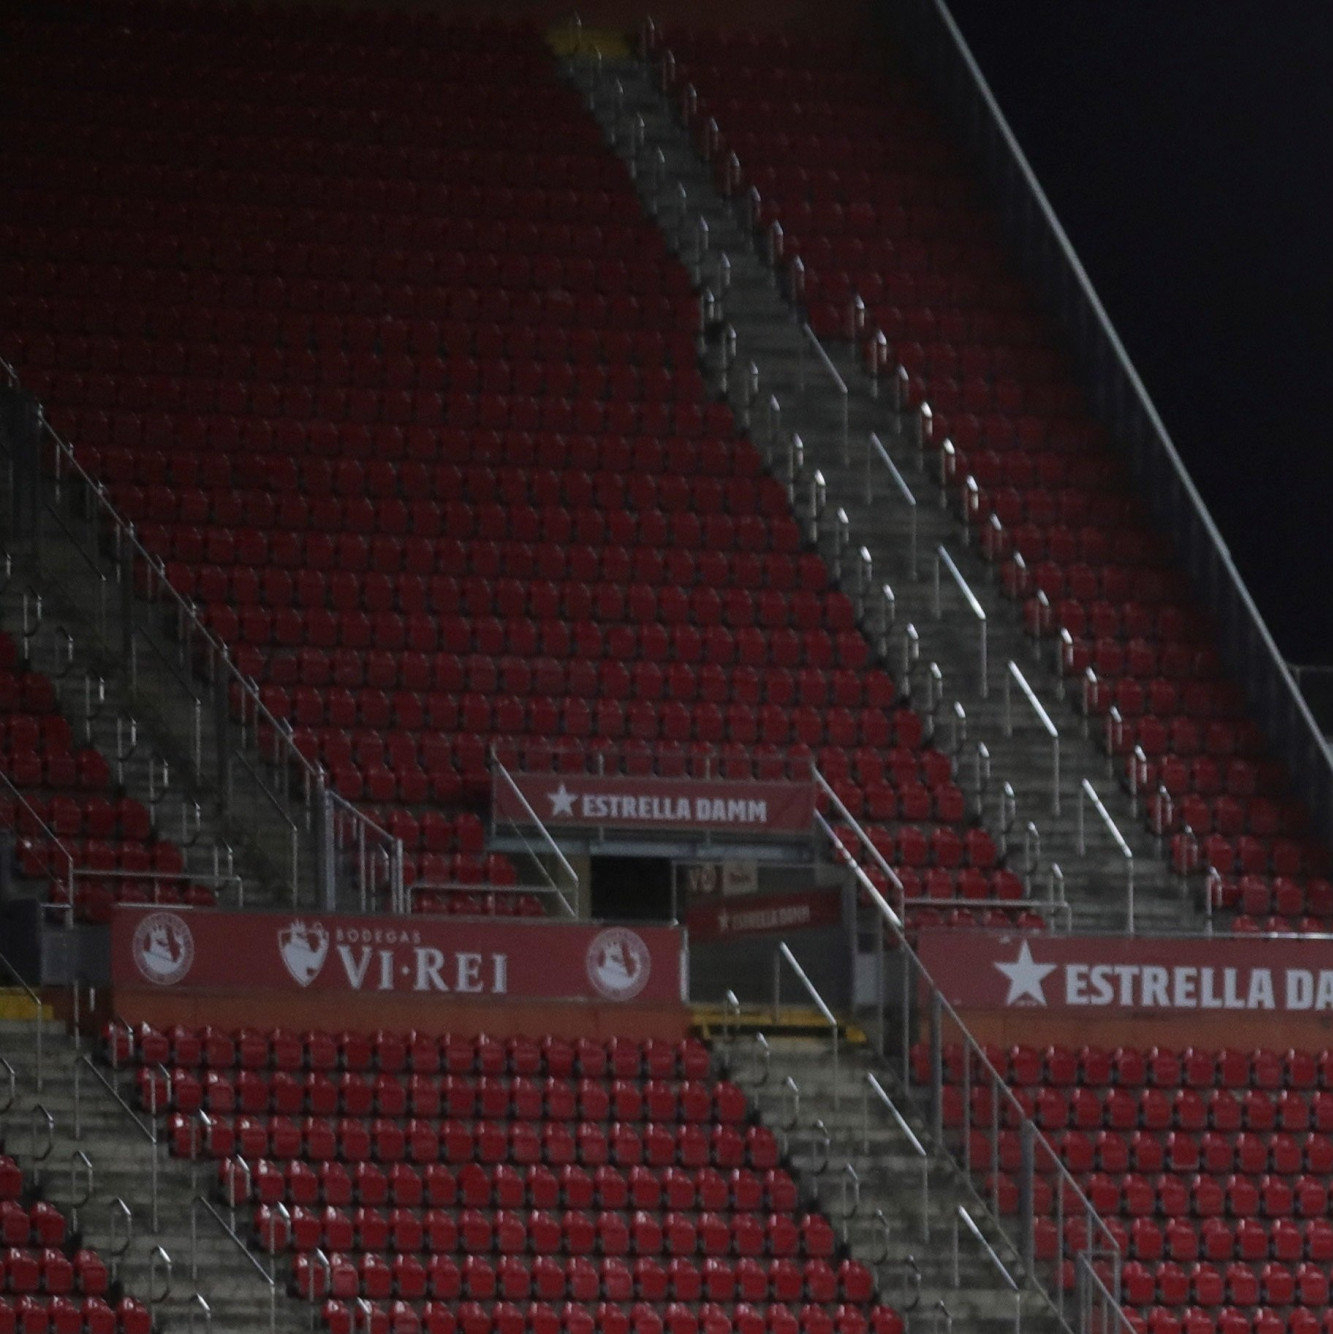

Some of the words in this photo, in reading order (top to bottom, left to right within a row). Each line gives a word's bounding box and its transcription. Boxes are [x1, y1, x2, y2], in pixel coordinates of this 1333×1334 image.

[582, 794, 692, 818] ESTRELLA
[696, 799, 767, 822] DAMM
[336, 928, 421, 943] BODEGAS
[1065, 964, 1276, 1009] ESTRELLA
